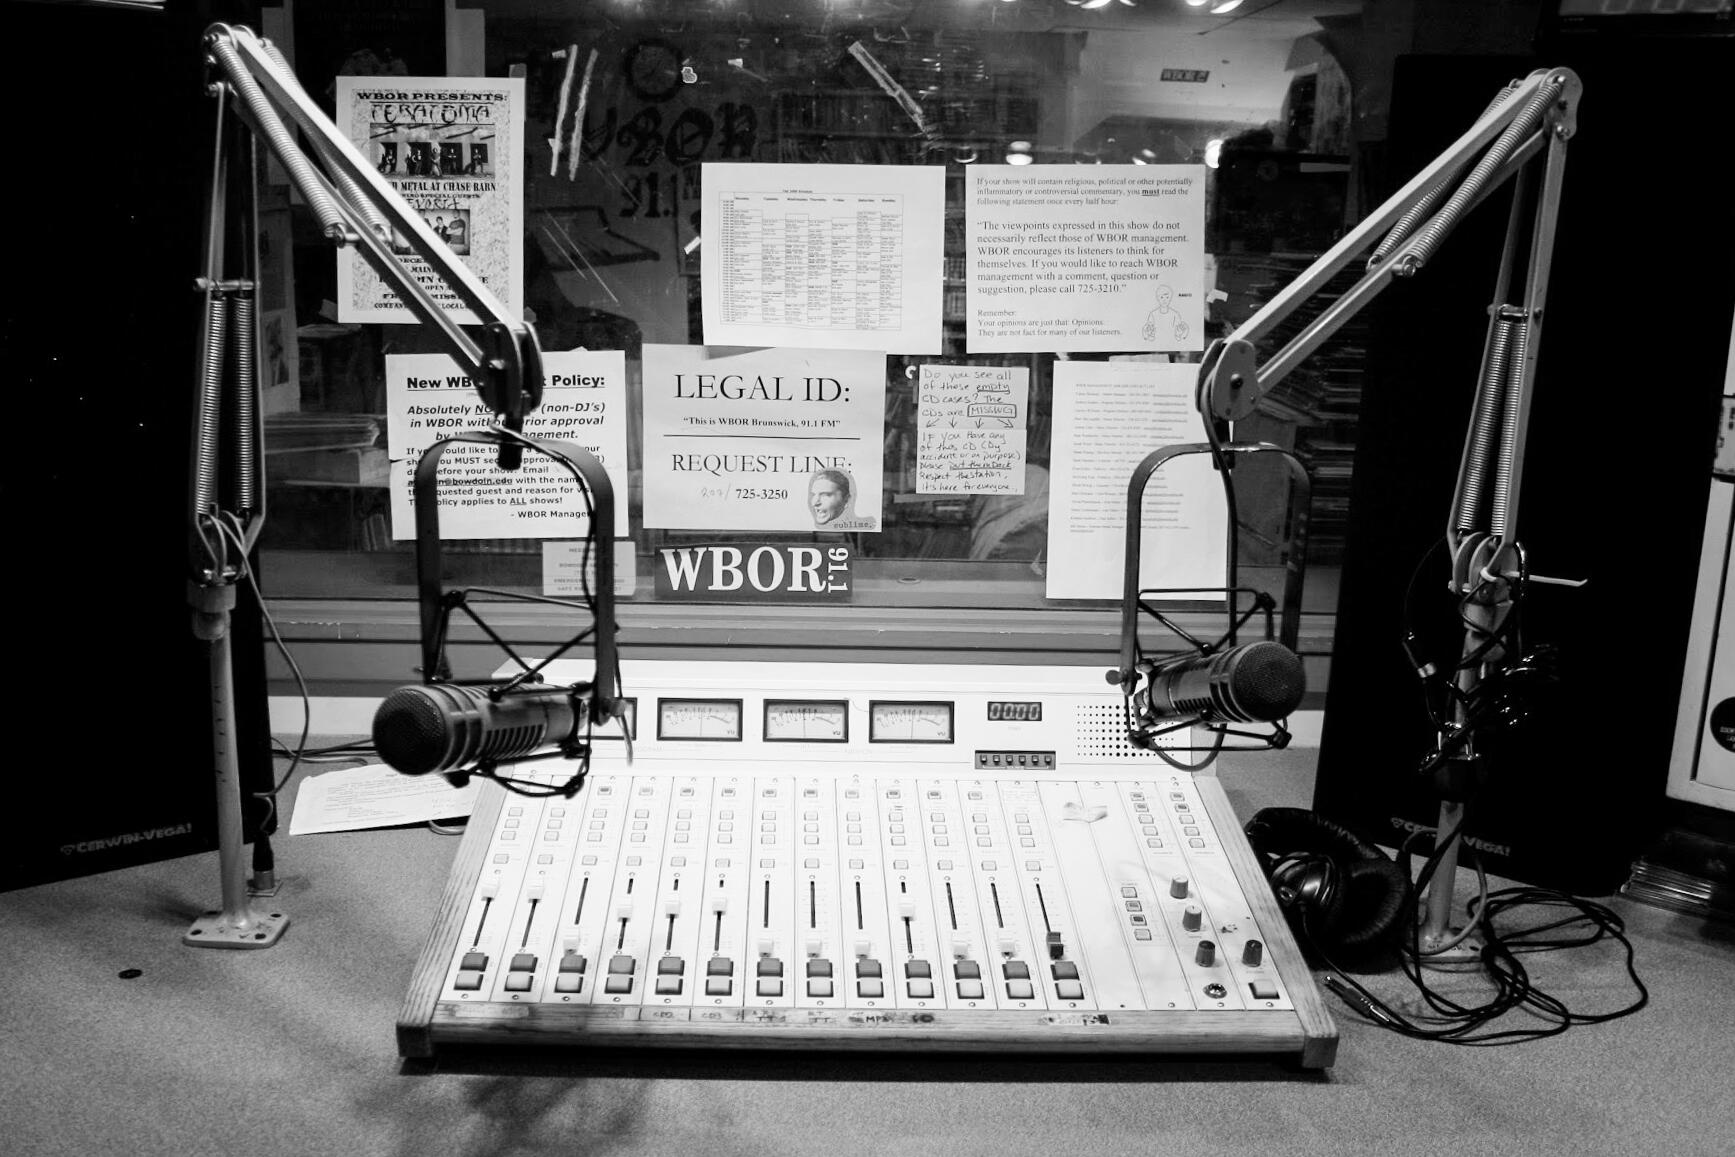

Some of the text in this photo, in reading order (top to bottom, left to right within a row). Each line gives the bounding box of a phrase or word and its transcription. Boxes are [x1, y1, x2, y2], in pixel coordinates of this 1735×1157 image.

[413, 93, 507, 101] PRESENTS:
[401, 182, 428, 191] METAL
[431, 182, 440, 191] AT
[444, 182, 470, 191] CHASE
[474, 182, 496, 192] BARN
[984, 179, 1001, 187] your
[1065, 178, 1096, 186] religious,
[1098, 178, 1126, 187] political
[1156, 178, 1193, 187] potentially
[978, 188, 1023, 196] inflammatory
[1080, 188, 1126, 196] commentary,
[1142, 188, 1160, 196] must
[977, 198, 1010, 206] following
[1002, 222, 1050, 232] viewpoints
[1053, 221, 1095, 232] expressed
[1098, 222, 1106, 230] in
[1109, 221, 1125, 230] this
[1127, 221, 1150, 230] show
[1152, 221, 1164, 230] do
[1166, 222, 1180, 230] not
[978, 234, 1188, 245] necessarily reflect those of WBOR management.
[978, 247, 1010, 256] WBOR
[1013, 248, 1062, 258] encourages
[1064, 247, 1075, 255] its
[1078, 246, 1113, 255] listeners
[1127, 246, 1149, 255] think
[1152, 246, 1165, 255] for
[978, 259, 1178, 270] themselves. If you would like to reach WBOR
[978, 274, 1033, 283] management
[1036, 272, 1055, 281] with
[1066, 273, 1109, 282] comment,
[1111, 272, 1148, 282] question
[978, 286, 1027, 296] suggestion,
[1030, 285, 1057, 296] please
[1060, 284, 1075, 294] call
[949, 372, 969, 382] you
[975, 371, 993, 379] see
[997, 370, 1012, 380] all
[407, 378, 442, 389] New
[552, 375, 605, 388] Policy:
[924, 380, 934, 390] of
[977, 382, 1011, 395] empty
[674, 374, 850, 402] LEGAL ID:
[408, 405, 471, 416] Absolutely
[410, 416, 604, 428] in WBOR rior approval
[718, 418, 750, 426] WBOR
[752, 418, 799, 428] Brunswick,
[801, 420, 818, 428] 91.1
[455, 457, 481, 465] MUST
[672, 454, 853, 477] REQUEST LINE:
[465, 468, 487, 476] your
[523, 466, 549, 474] Email
[476, 489, 502, 497] guest
[736, 489, 788, 500] 725-3250
[437, 499, 458, 507] olicy
[461, 498, 495, 507] applies
[660, 546, 826, 592] WBOR
[828, 548, 849, 593] 91.1
